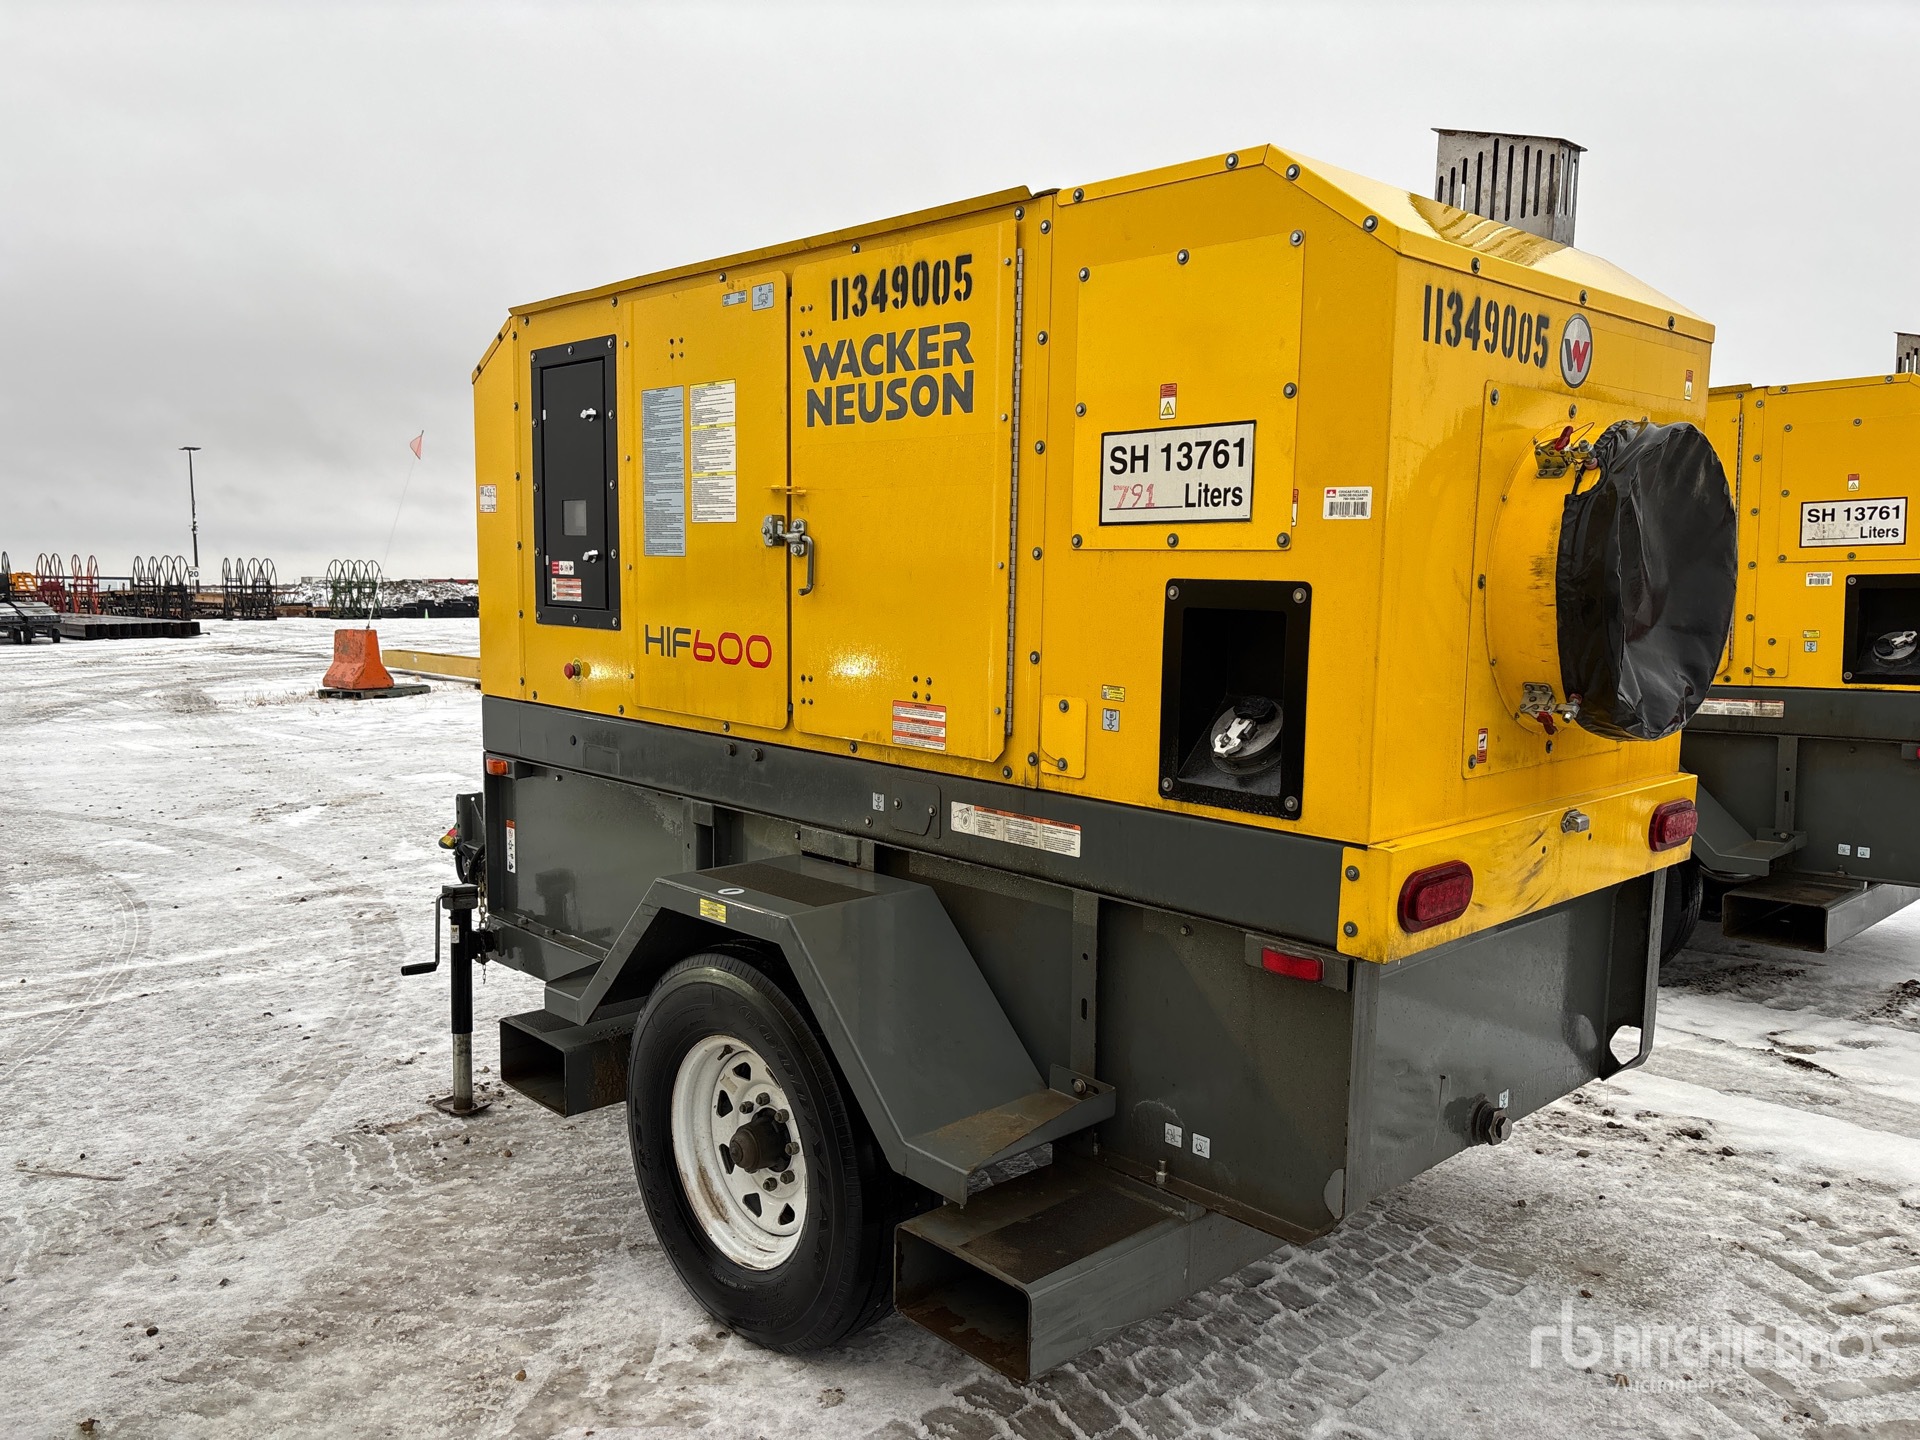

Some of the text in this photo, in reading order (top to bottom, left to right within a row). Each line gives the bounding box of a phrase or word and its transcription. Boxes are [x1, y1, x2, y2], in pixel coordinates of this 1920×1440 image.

[832, 254, 973, 321] 11349005
[1423, 284, 1550, 369] 11349005
[803, 321, 975, 383] WACKER
[806, 369, 975, 428] NEUSON
[1109, 437, 1246, 475] SH 13761
[1112, 481, 1244, 509] 791 Liters
[1806, 504, 1900, 523] SH 13761
[1859, 525, 1900, 540] Liters
[644, 623, 773, 669] HIF600
